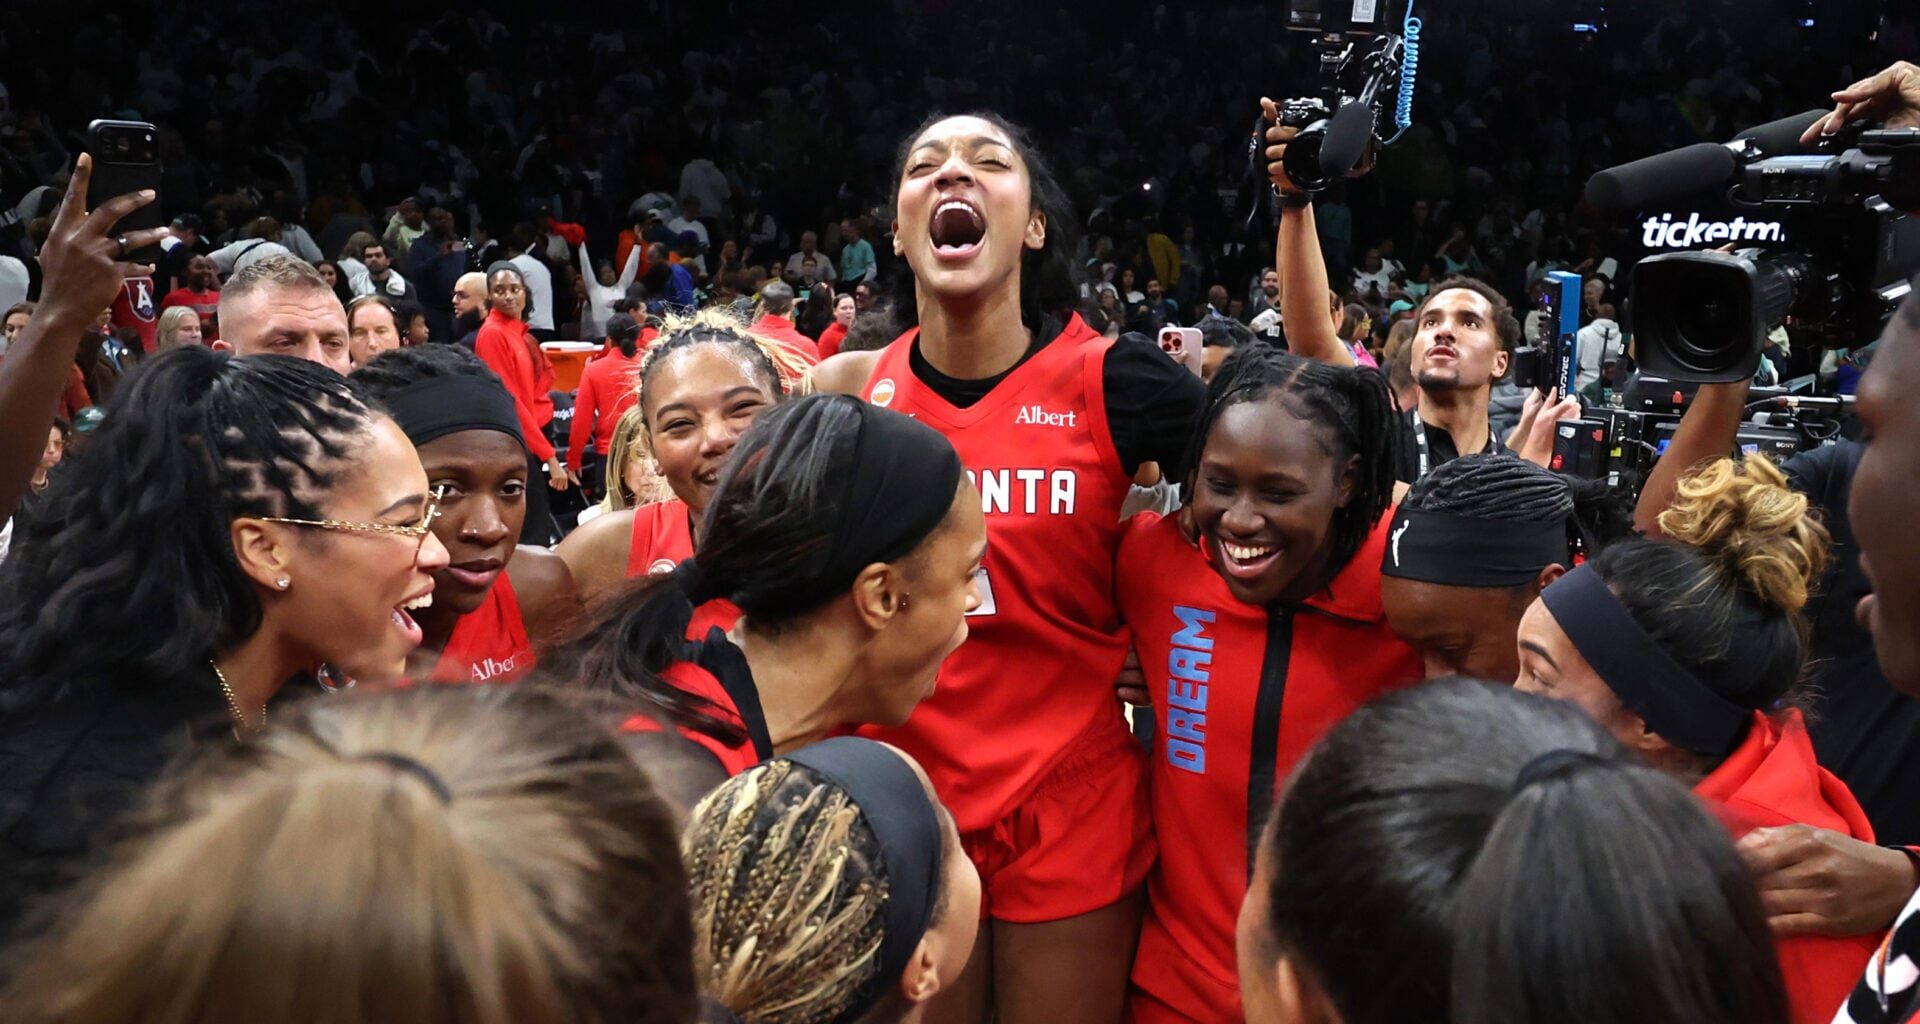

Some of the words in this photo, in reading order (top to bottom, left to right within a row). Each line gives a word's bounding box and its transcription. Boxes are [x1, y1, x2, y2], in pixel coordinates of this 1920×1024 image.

[1642, 212, 1785, 248] ticketm
[1015, 405, 1077, 428] Albert
[1775, 441, 1796, 449] SONY
[966, 468, 1077, 515] NTA
[471, 655, 515, 681] Alber
[1167, 605, 1217, 775] DREAM
